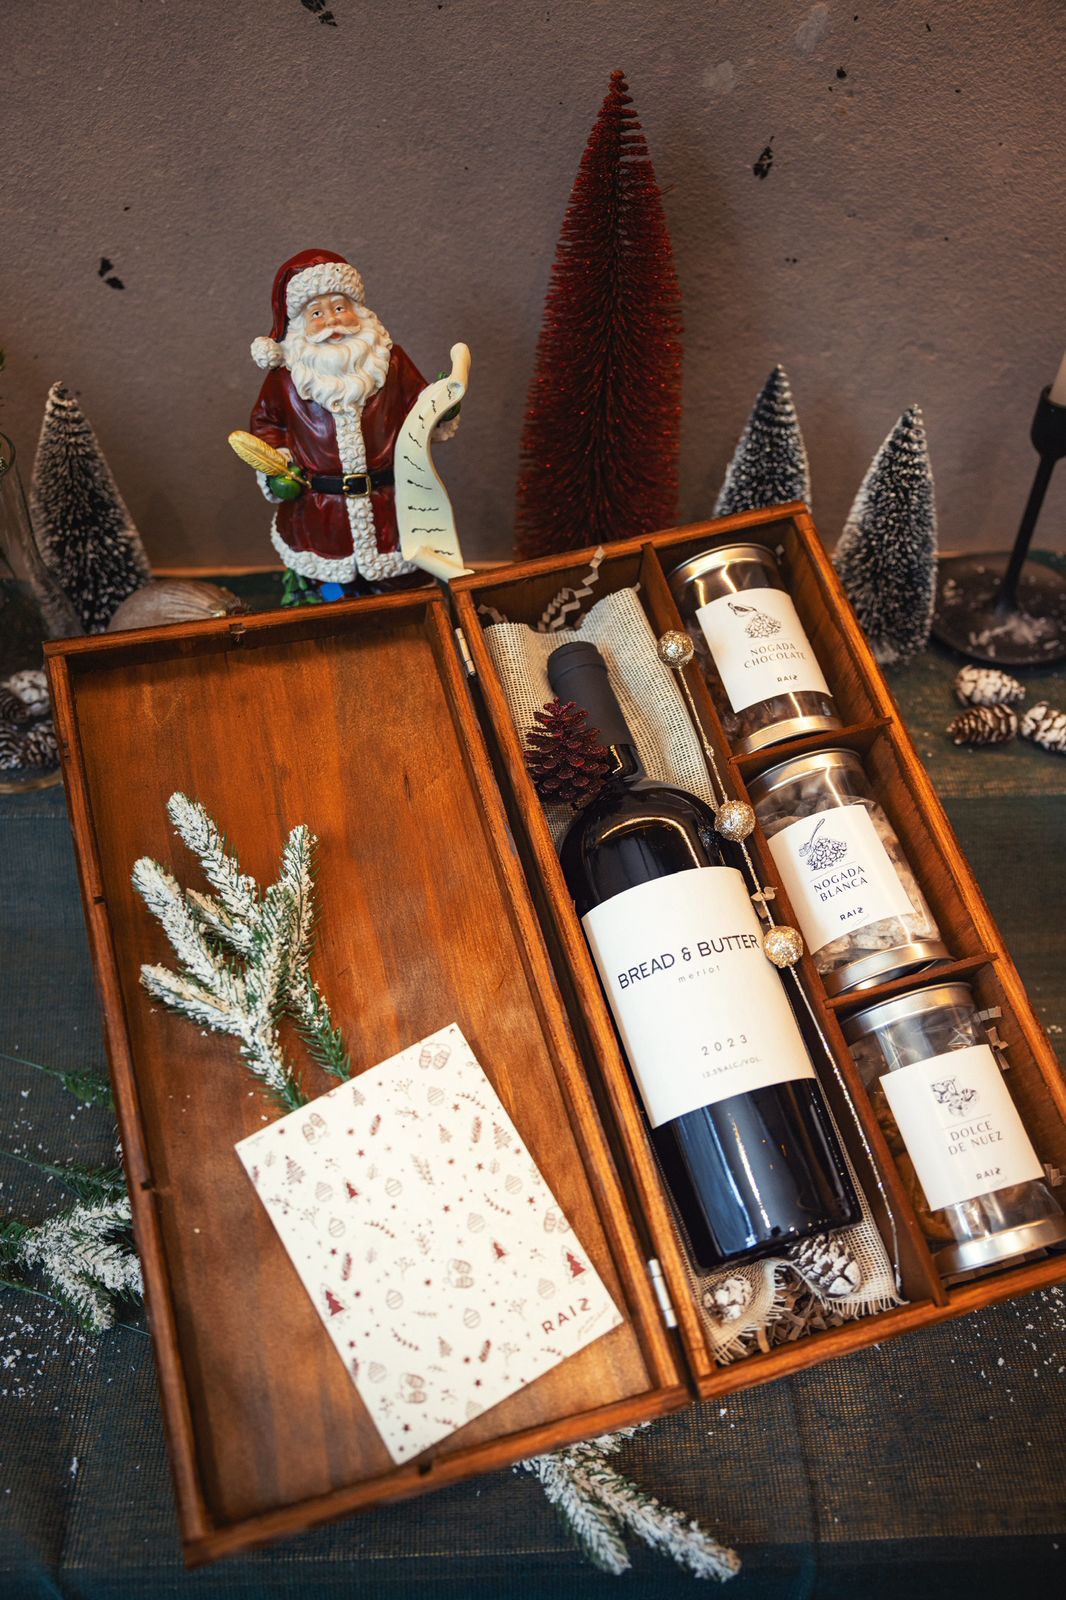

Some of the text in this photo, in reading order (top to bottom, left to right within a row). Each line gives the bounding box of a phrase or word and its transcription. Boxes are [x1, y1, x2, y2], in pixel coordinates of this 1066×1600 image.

[744, 651, 807, 669] CHOCOLATE
[750, 642, 796, 656] NOGADA
[813, 866, 866, 893] NOGADA
[820, 877, 868, 902] BLANCA
[617, 934, 760, 990] BREAD & BUTTER
[678, 964, 721, 984] merlot
[701, 1034, 748, 1056] 2023
[950, 1120, 993, 1142] DOLCE
[948, 1131, 1004, 1156] DE NUEZ
[541, 1297, 592, 1335] RAIZ
